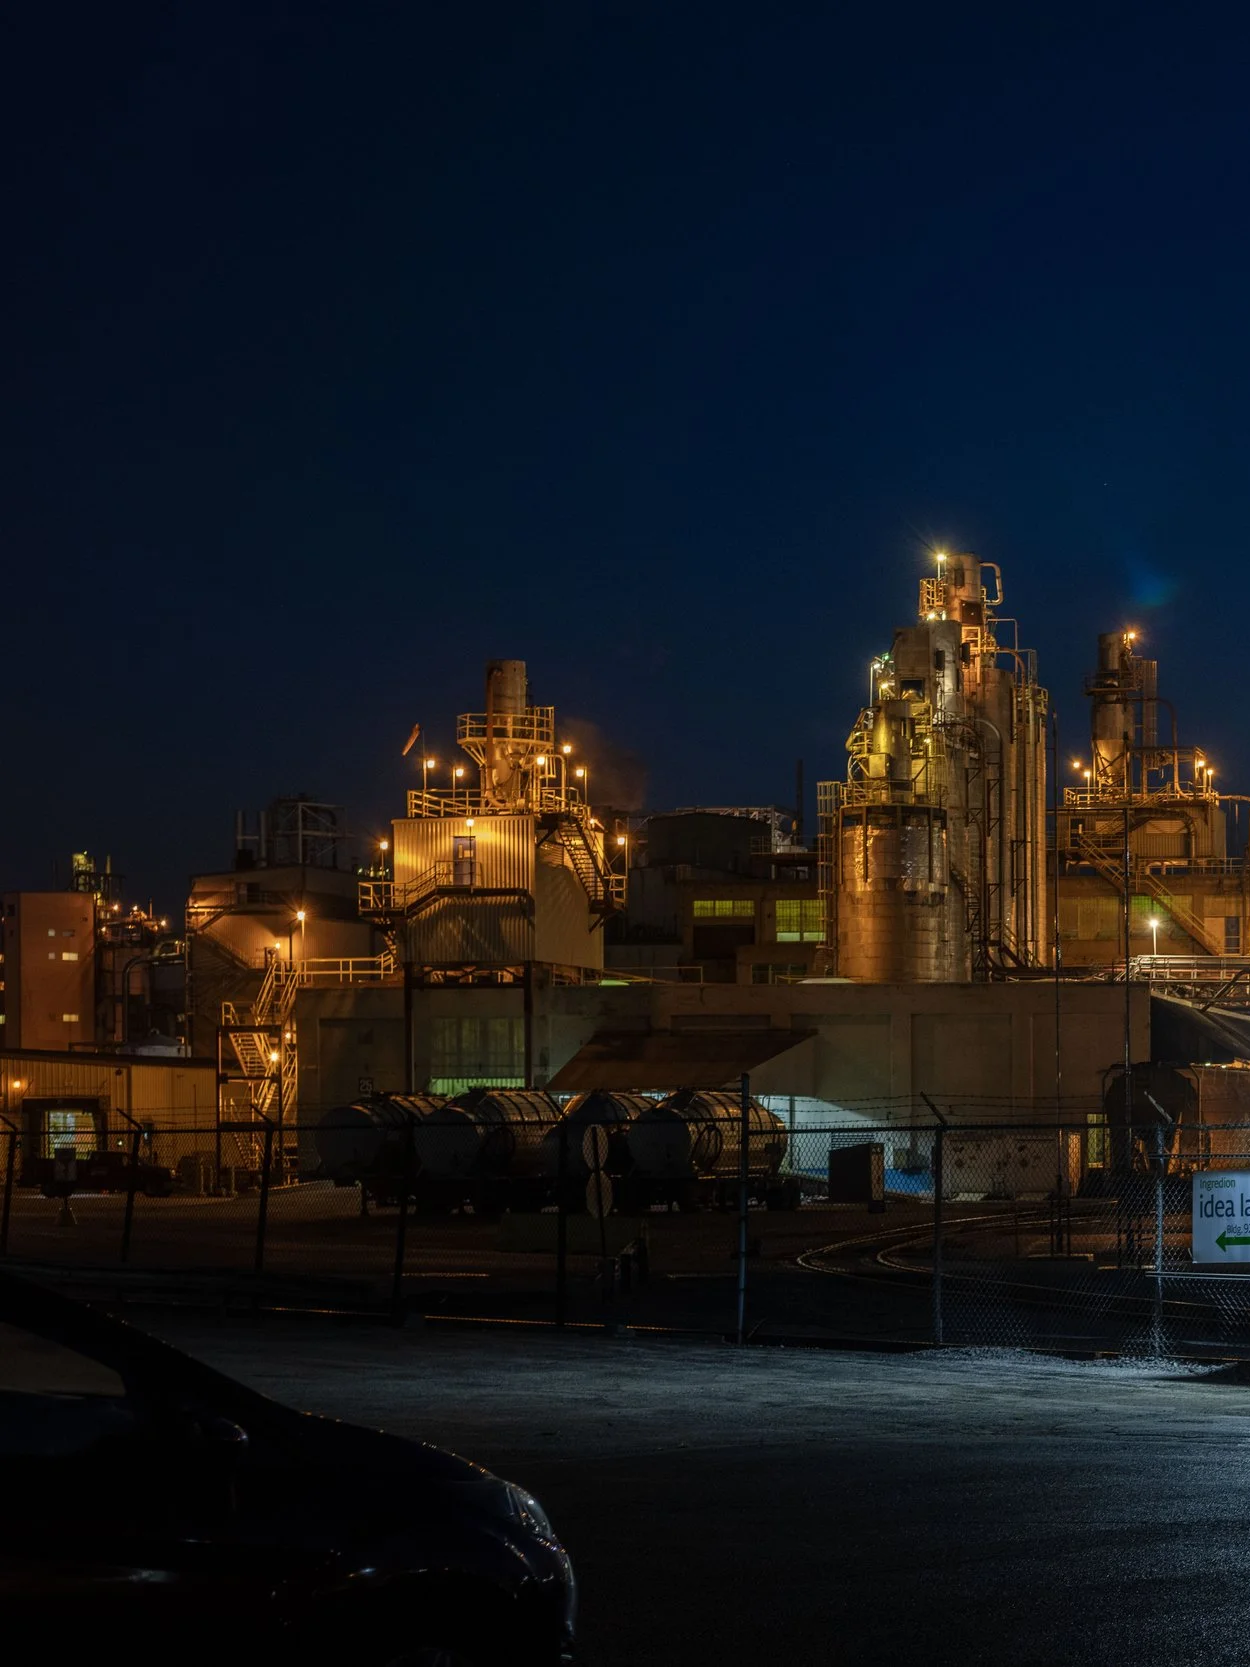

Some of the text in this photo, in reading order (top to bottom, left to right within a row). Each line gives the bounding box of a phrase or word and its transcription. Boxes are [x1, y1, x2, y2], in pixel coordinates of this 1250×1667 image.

[1199, 1177, 1236, 1191] Ingredion
[1199, 1194, 1235, 1218] idea
[1226, 1224, 1243, 1236] Bldg.
